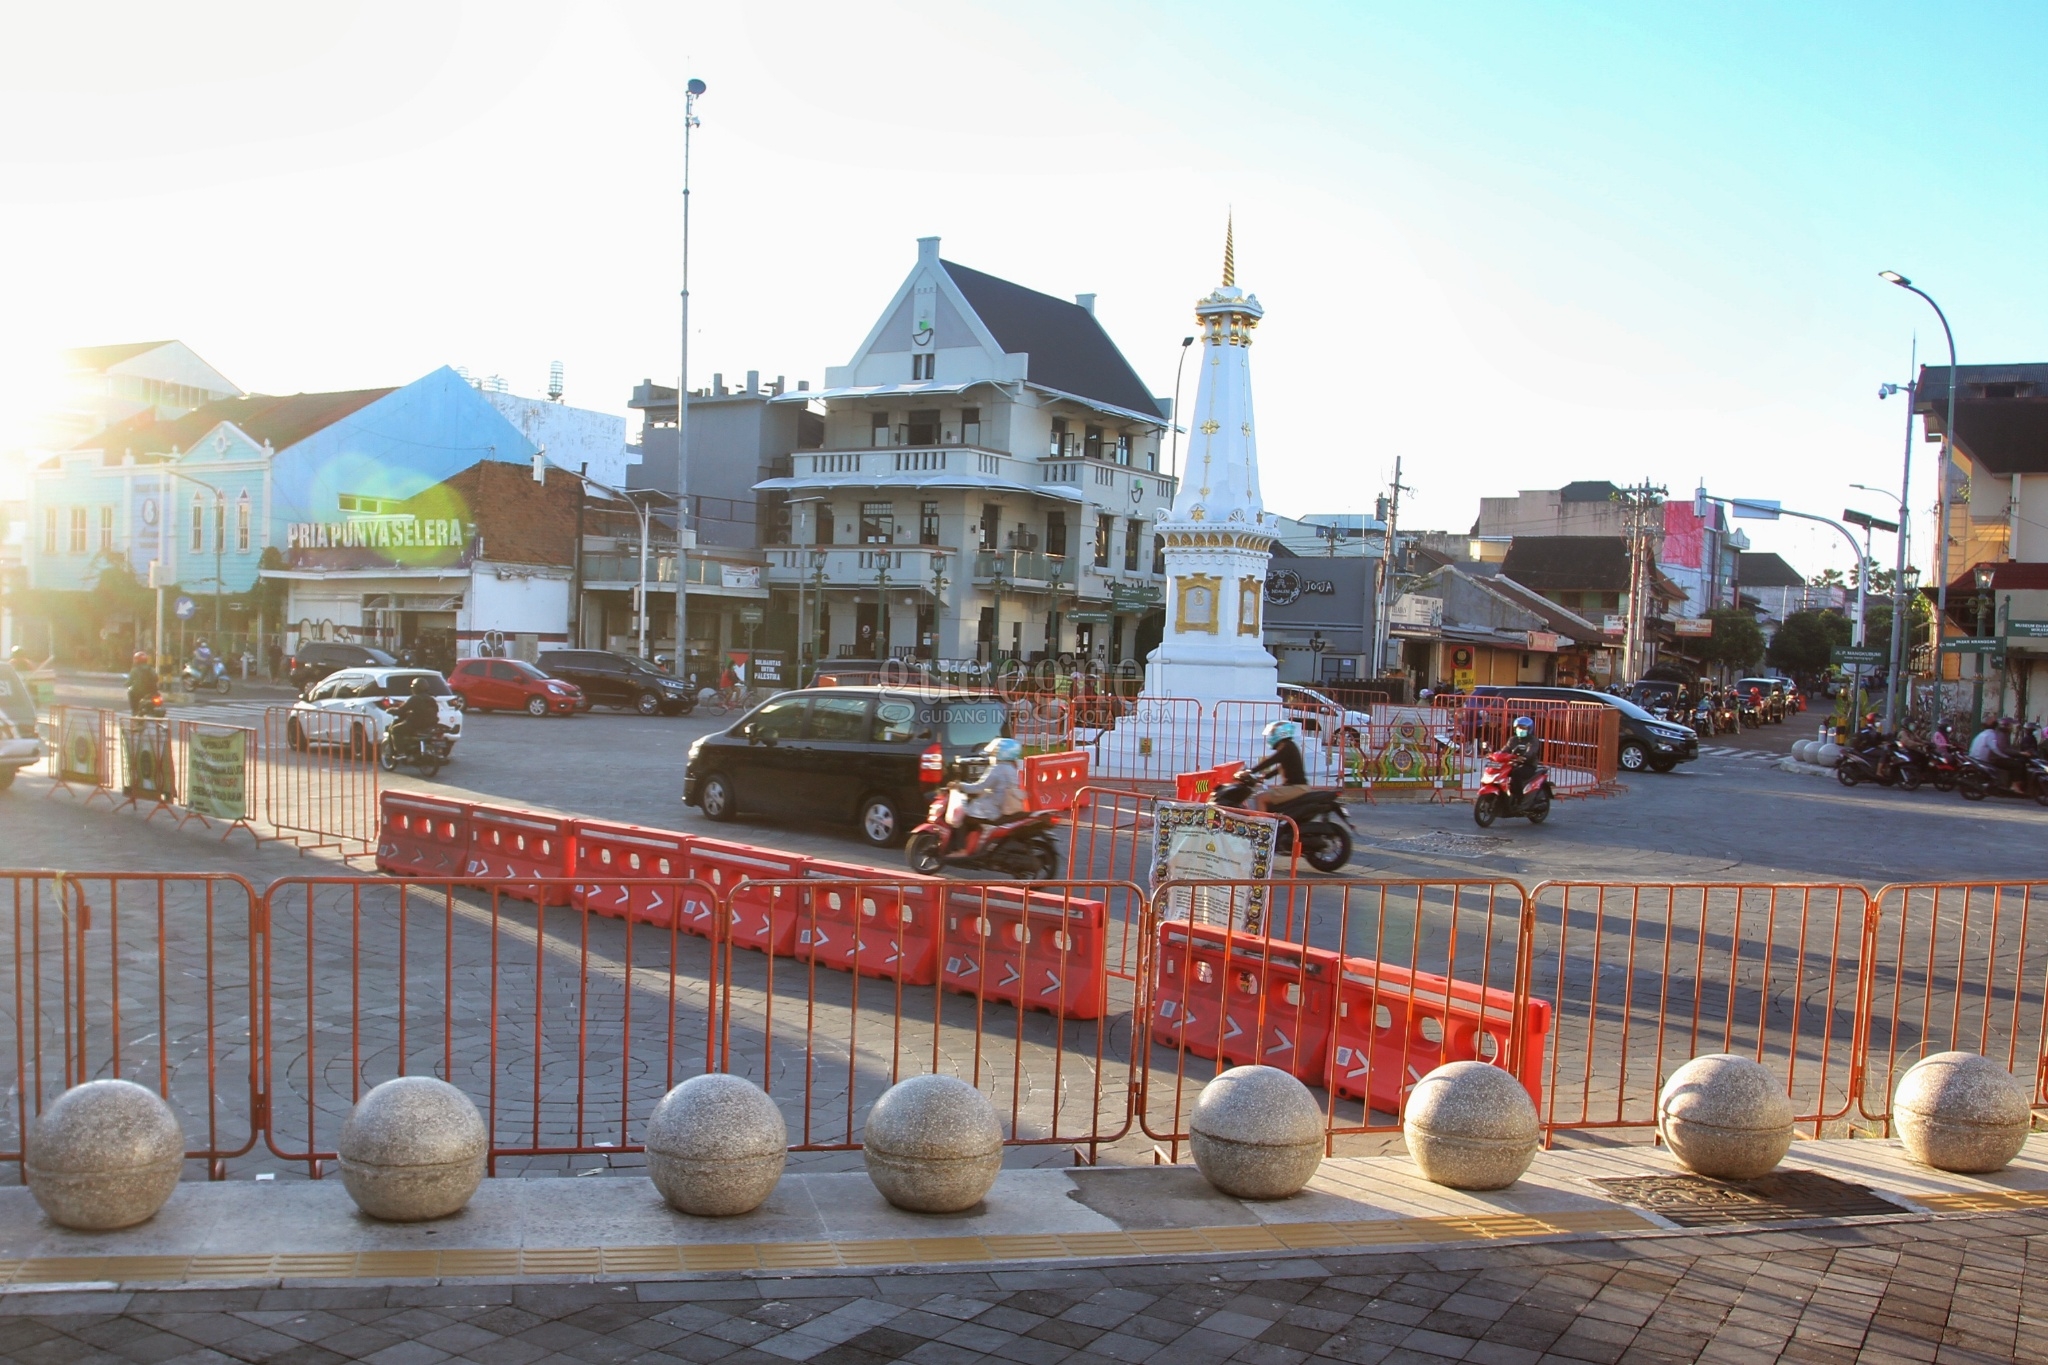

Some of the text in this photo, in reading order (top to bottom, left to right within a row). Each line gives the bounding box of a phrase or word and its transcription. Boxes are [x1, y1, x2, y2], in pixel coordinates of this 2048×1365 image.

[288, 518, 463, 549] PRIA PUNYA SELERA
[1305, 580, 1333, 593] JOGJA
